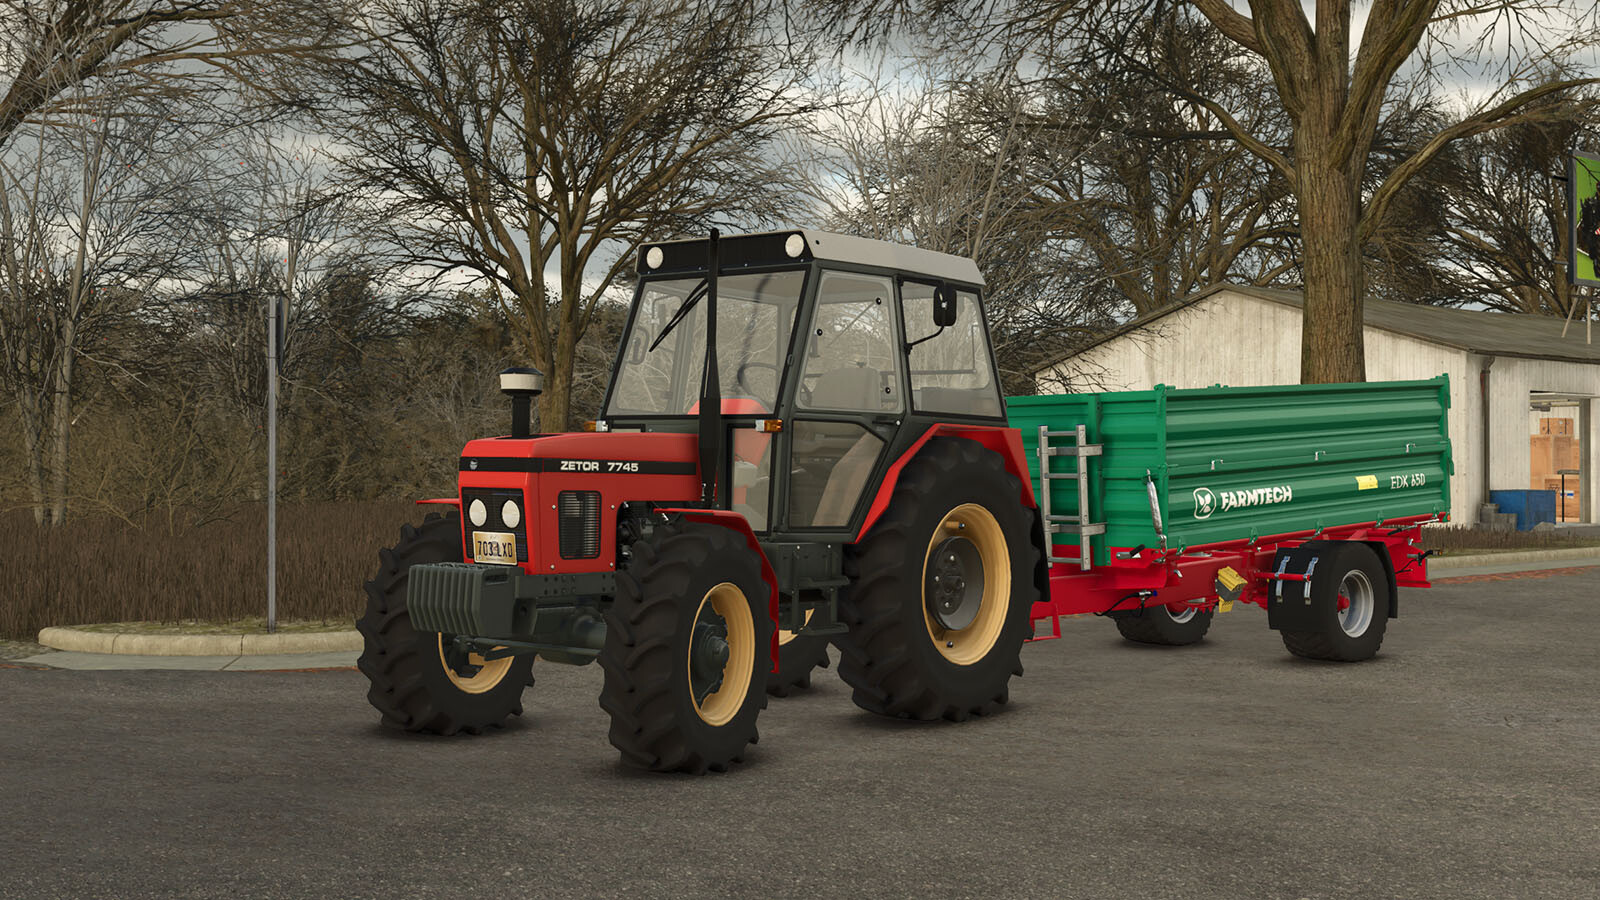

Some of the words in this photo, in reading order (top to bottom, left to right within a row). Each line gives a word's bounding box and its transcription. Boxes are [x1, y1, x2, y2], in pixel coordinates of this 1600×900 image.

[560, 461, 600, 471] ZETOR
[607, 462, 639, 472] 7745
[1411, 473, 1426, 487] 650
[1220, 485, 1293, 512] FARMTECH
